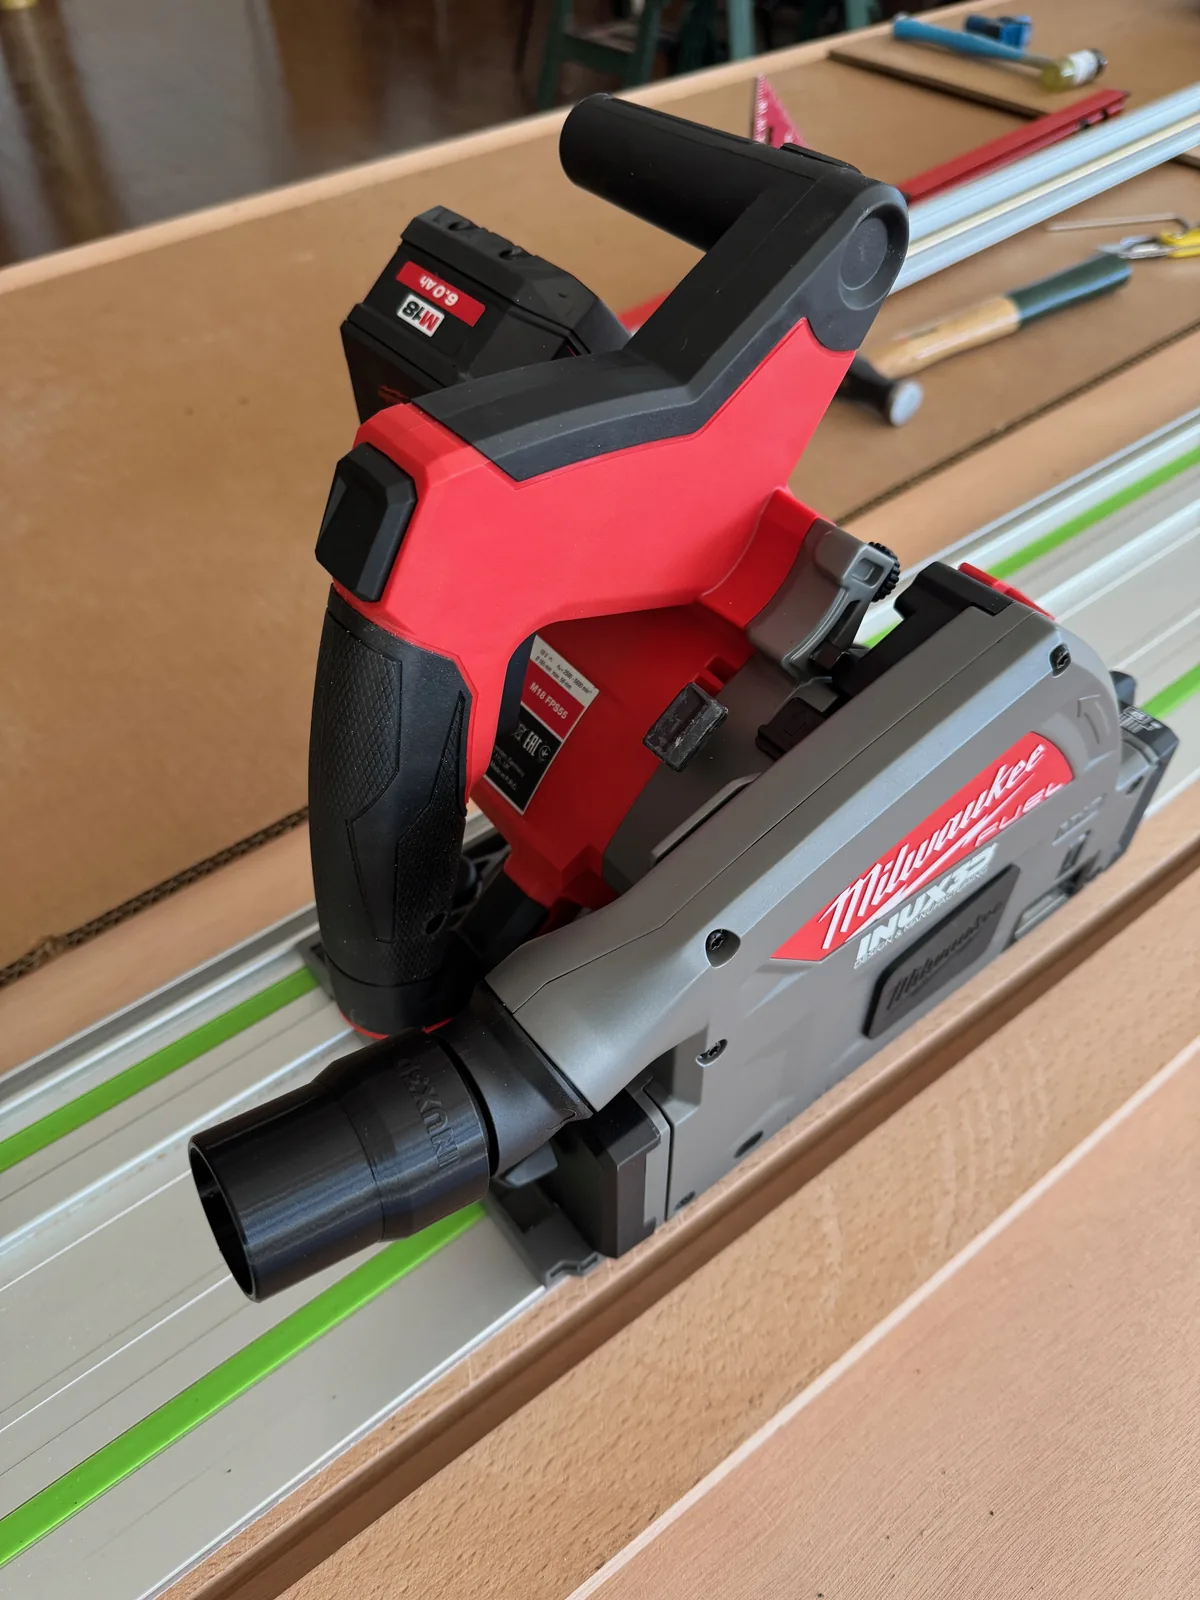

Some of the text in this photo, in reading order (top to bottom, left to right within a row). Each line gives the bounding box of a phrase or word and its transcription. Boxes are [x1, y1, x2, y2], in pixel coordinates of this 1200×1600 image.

[402, 300, 440, 332] M18
[530, 682, 569, 719] M18 FPS55
[974, 782, 1064, 848] FUEL
[818, 743, 1046, 950] Milwaukee
